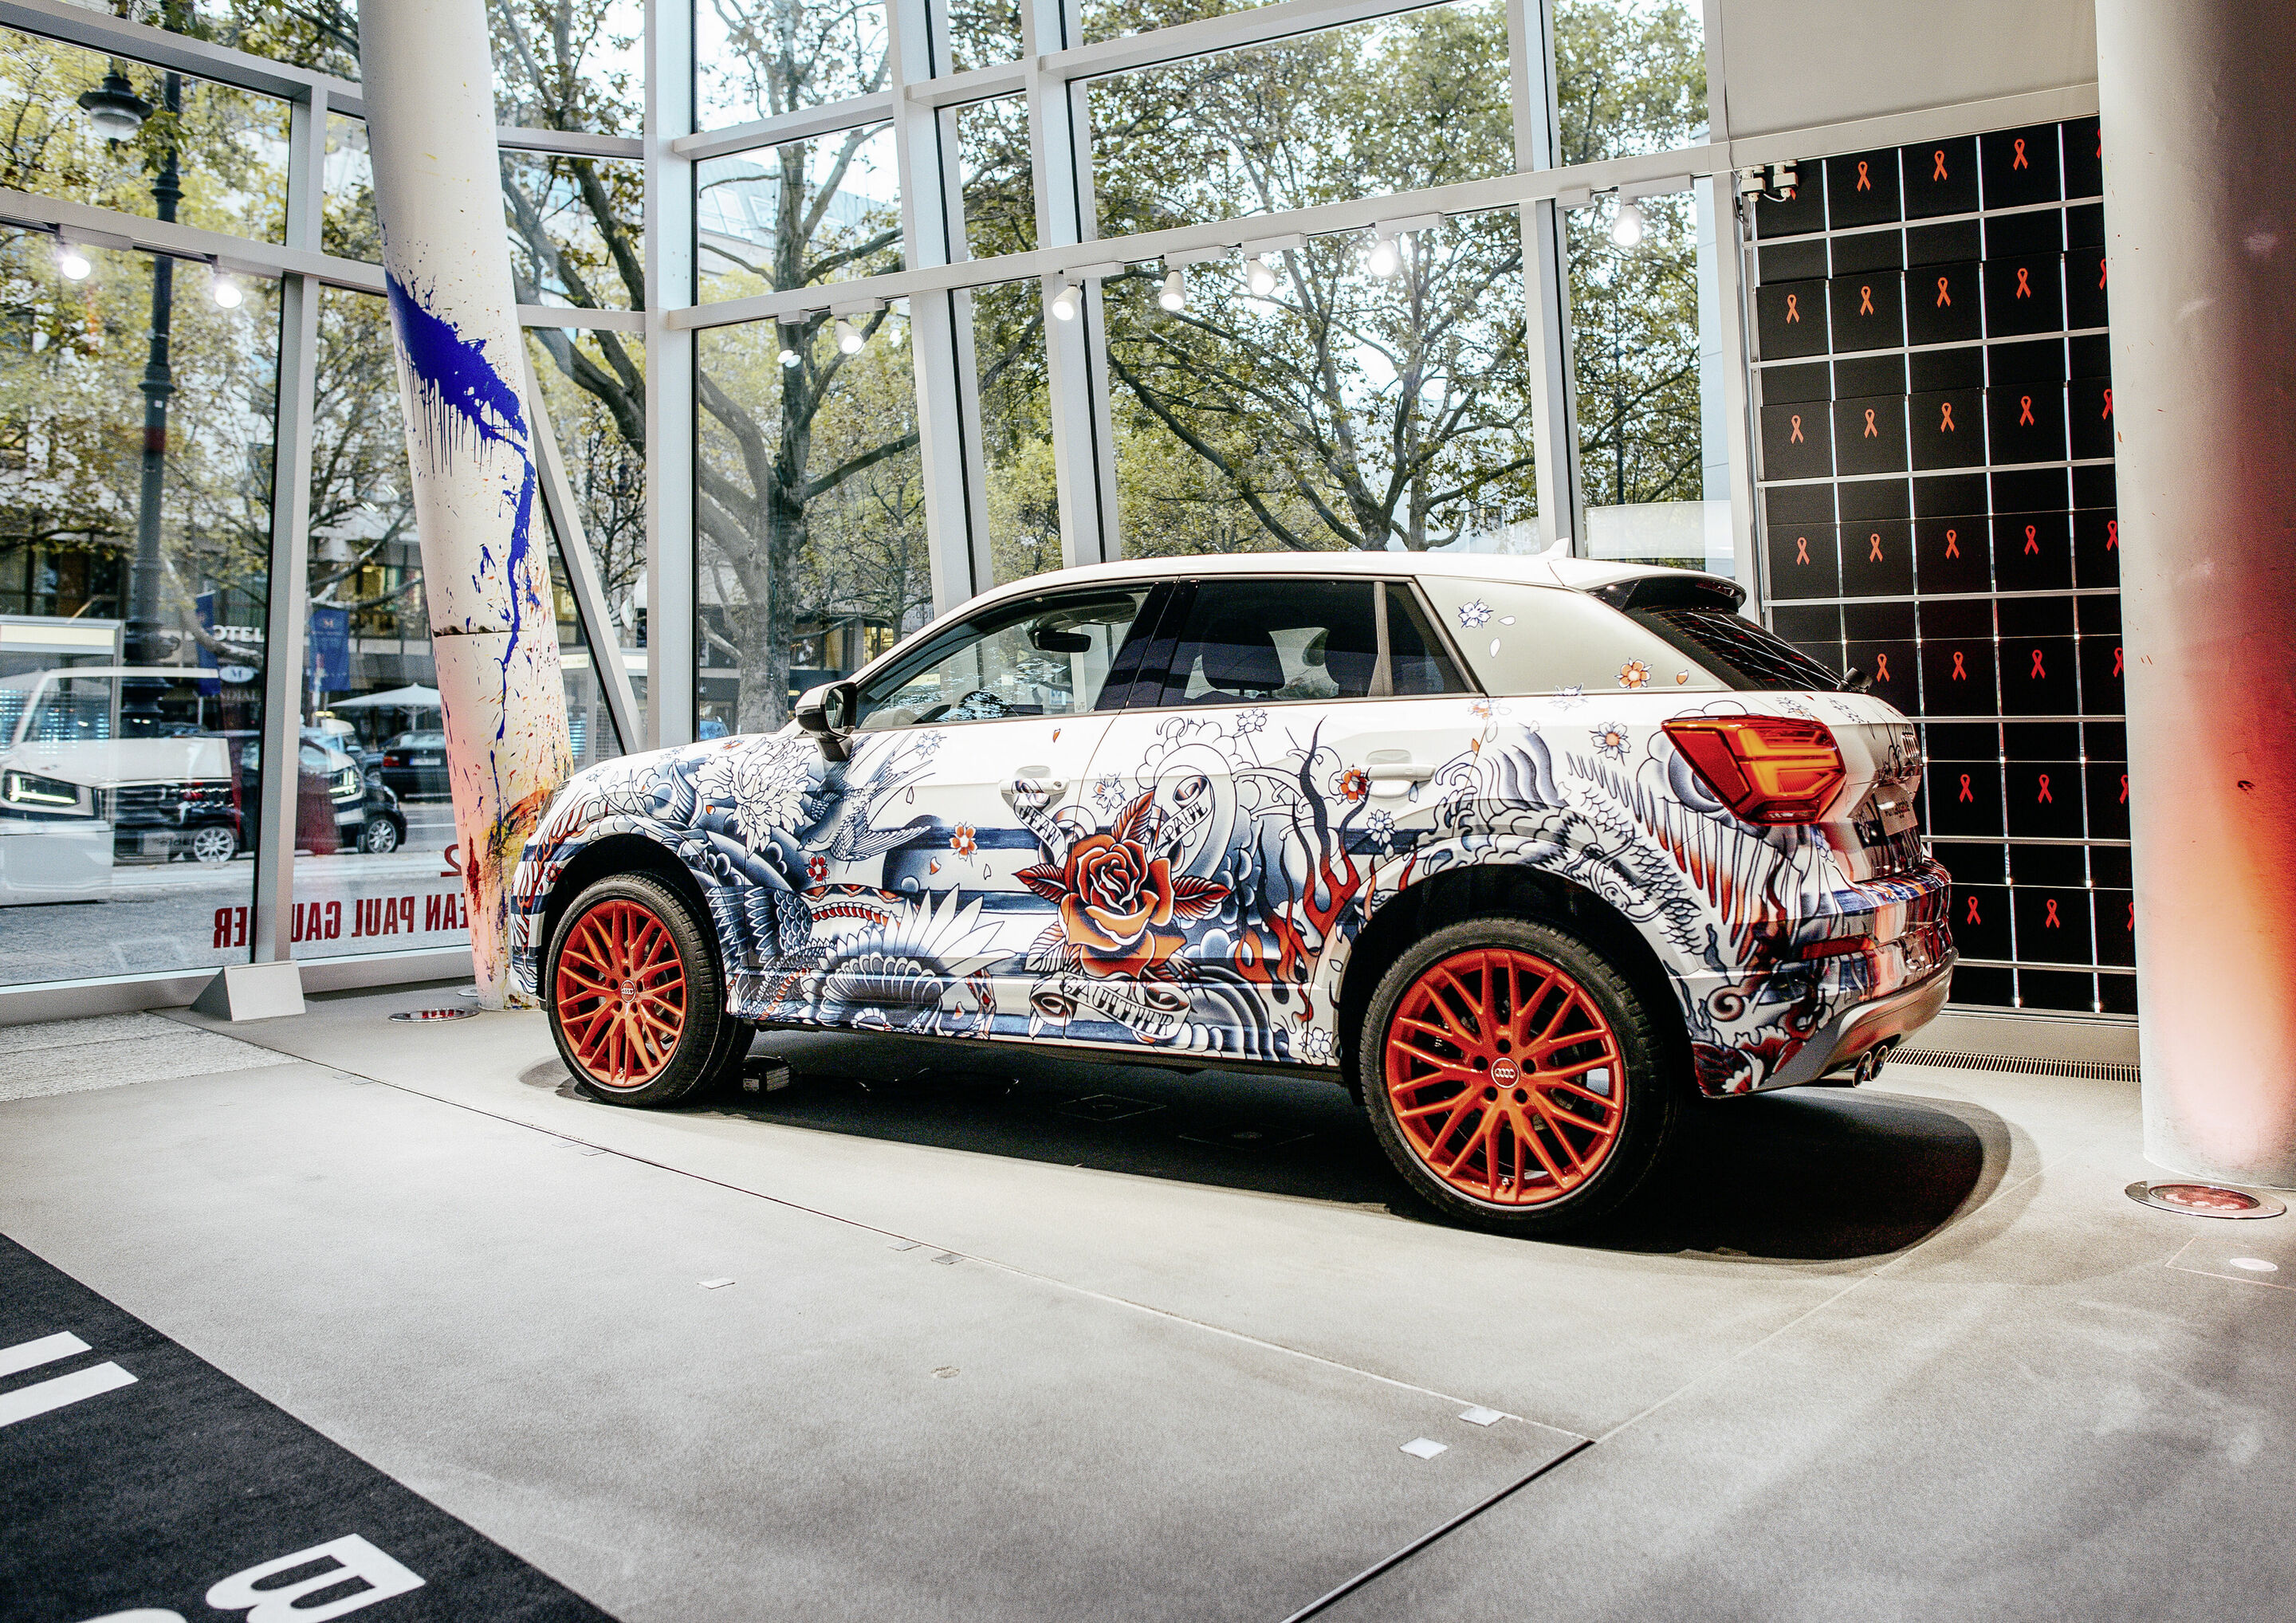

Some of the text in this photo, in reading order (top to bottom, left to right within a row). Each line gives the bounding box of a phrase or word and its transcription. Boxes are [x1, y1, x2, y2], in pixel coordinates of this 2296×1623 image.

[212, 624, 265, 643] OTEL
[1019, 801, 1209, 846] JEAN PAUL
[1060, 975, 1174, 1036] GAULTIER
